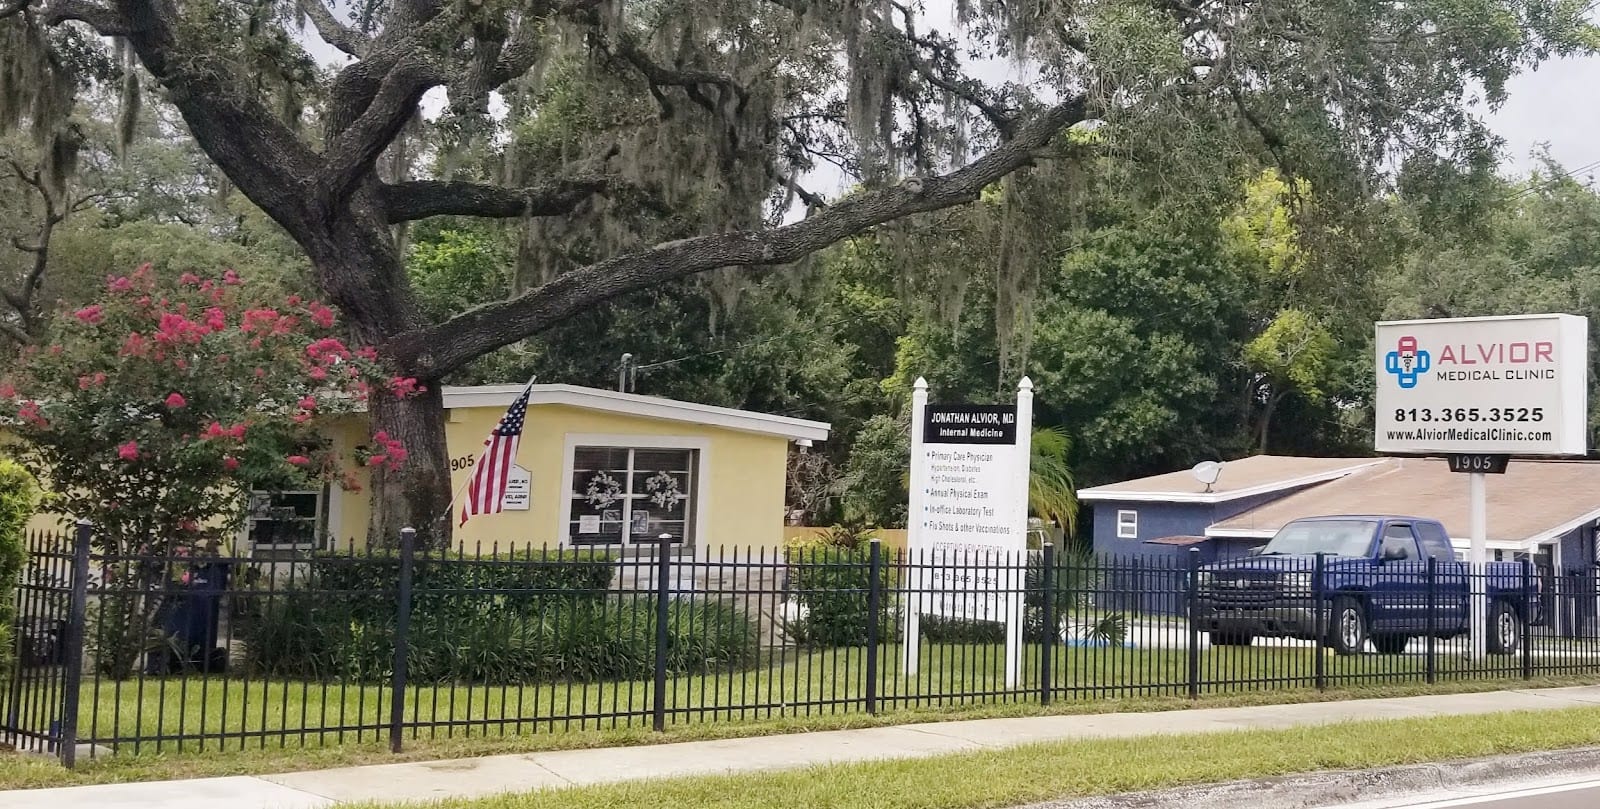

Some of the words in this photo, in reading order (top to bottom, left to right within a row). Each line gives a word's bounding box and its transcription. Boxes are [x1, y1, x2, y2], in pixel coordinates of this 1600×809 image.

[1438, 342, 1554, 365] ALVIOR
[1437, 370, 1500, 381] MEDICAL
[1505, 369, 1555, 380] CLINIC
[931, 412, 970, 424] JONATHAN
[971, 412, 1001, 426] ALVIOR,
[1394, 408, 1544, 422] 813.365.3525
[939, 427, 968, 437] Internal
[969, 427, 1004, 438] Medicine
[1386, 428, 1552, 441] www.AlviorMedicalClinic.com
[451, 454, 475, 471] 905
[931, 450, 952, 463] Primary
[953, 451, 966, 461] Care
[966, 451, 993, 463] Physician
[1455, 456, 1492, 470] 1905
[930, 487, 949, 498] Annual
[949, 487, 973, 501] Physical
[973, 488, 989, 499] Exam
[929, 504, 952, 515] In-office
[952, 505, 982, 518] Laboratory
[982, 506, 995, 517] Test
[938, 521, 954, 532] Shots
[954, 522, 959, 532] &
[960, 523, 975, 533] other
[975, 523, 1010, 535] Vaccinations
